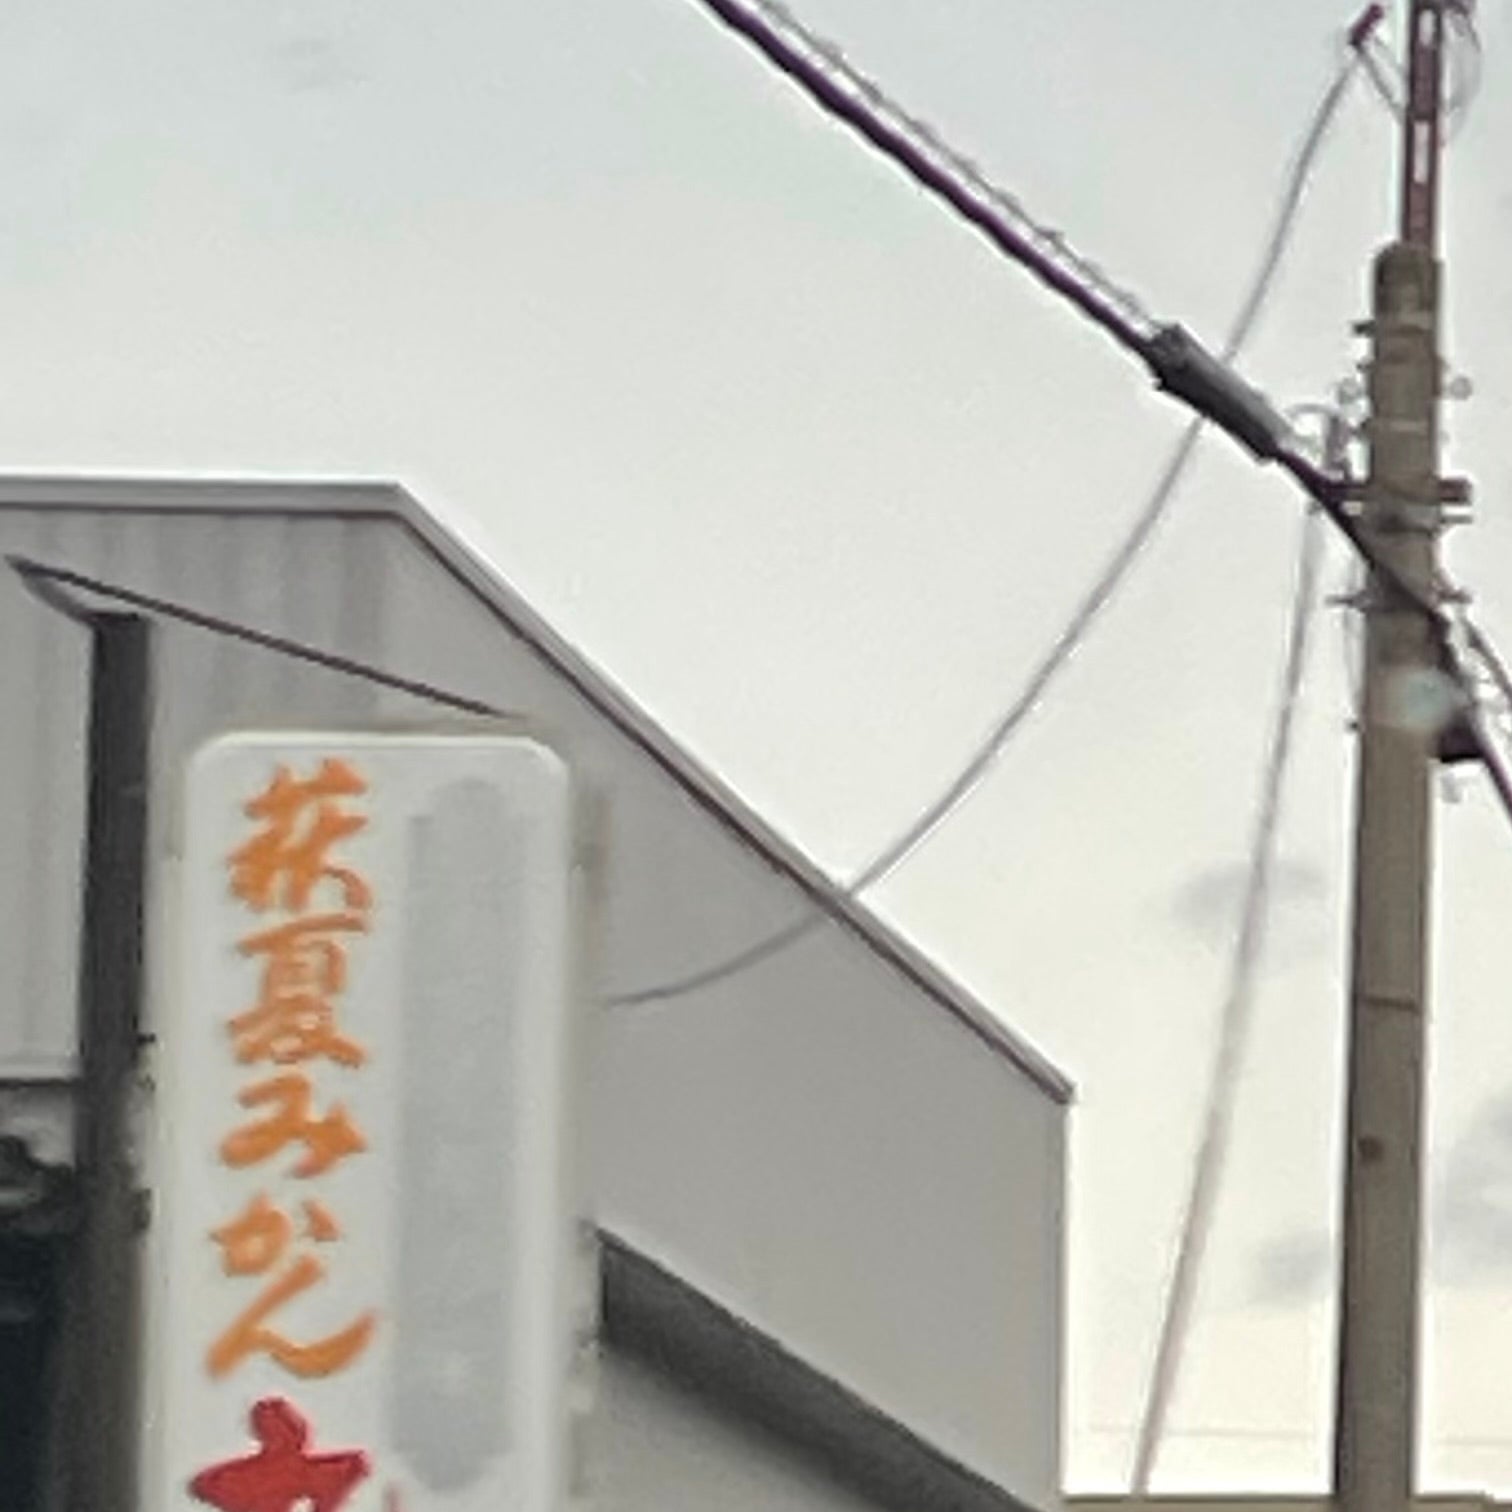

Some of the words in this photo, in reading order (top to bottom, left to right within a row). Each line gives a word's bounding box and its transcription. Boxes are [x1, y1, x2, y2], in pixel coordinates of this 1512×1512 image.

[205, 756, 379, 1380] 萩夏みかん
